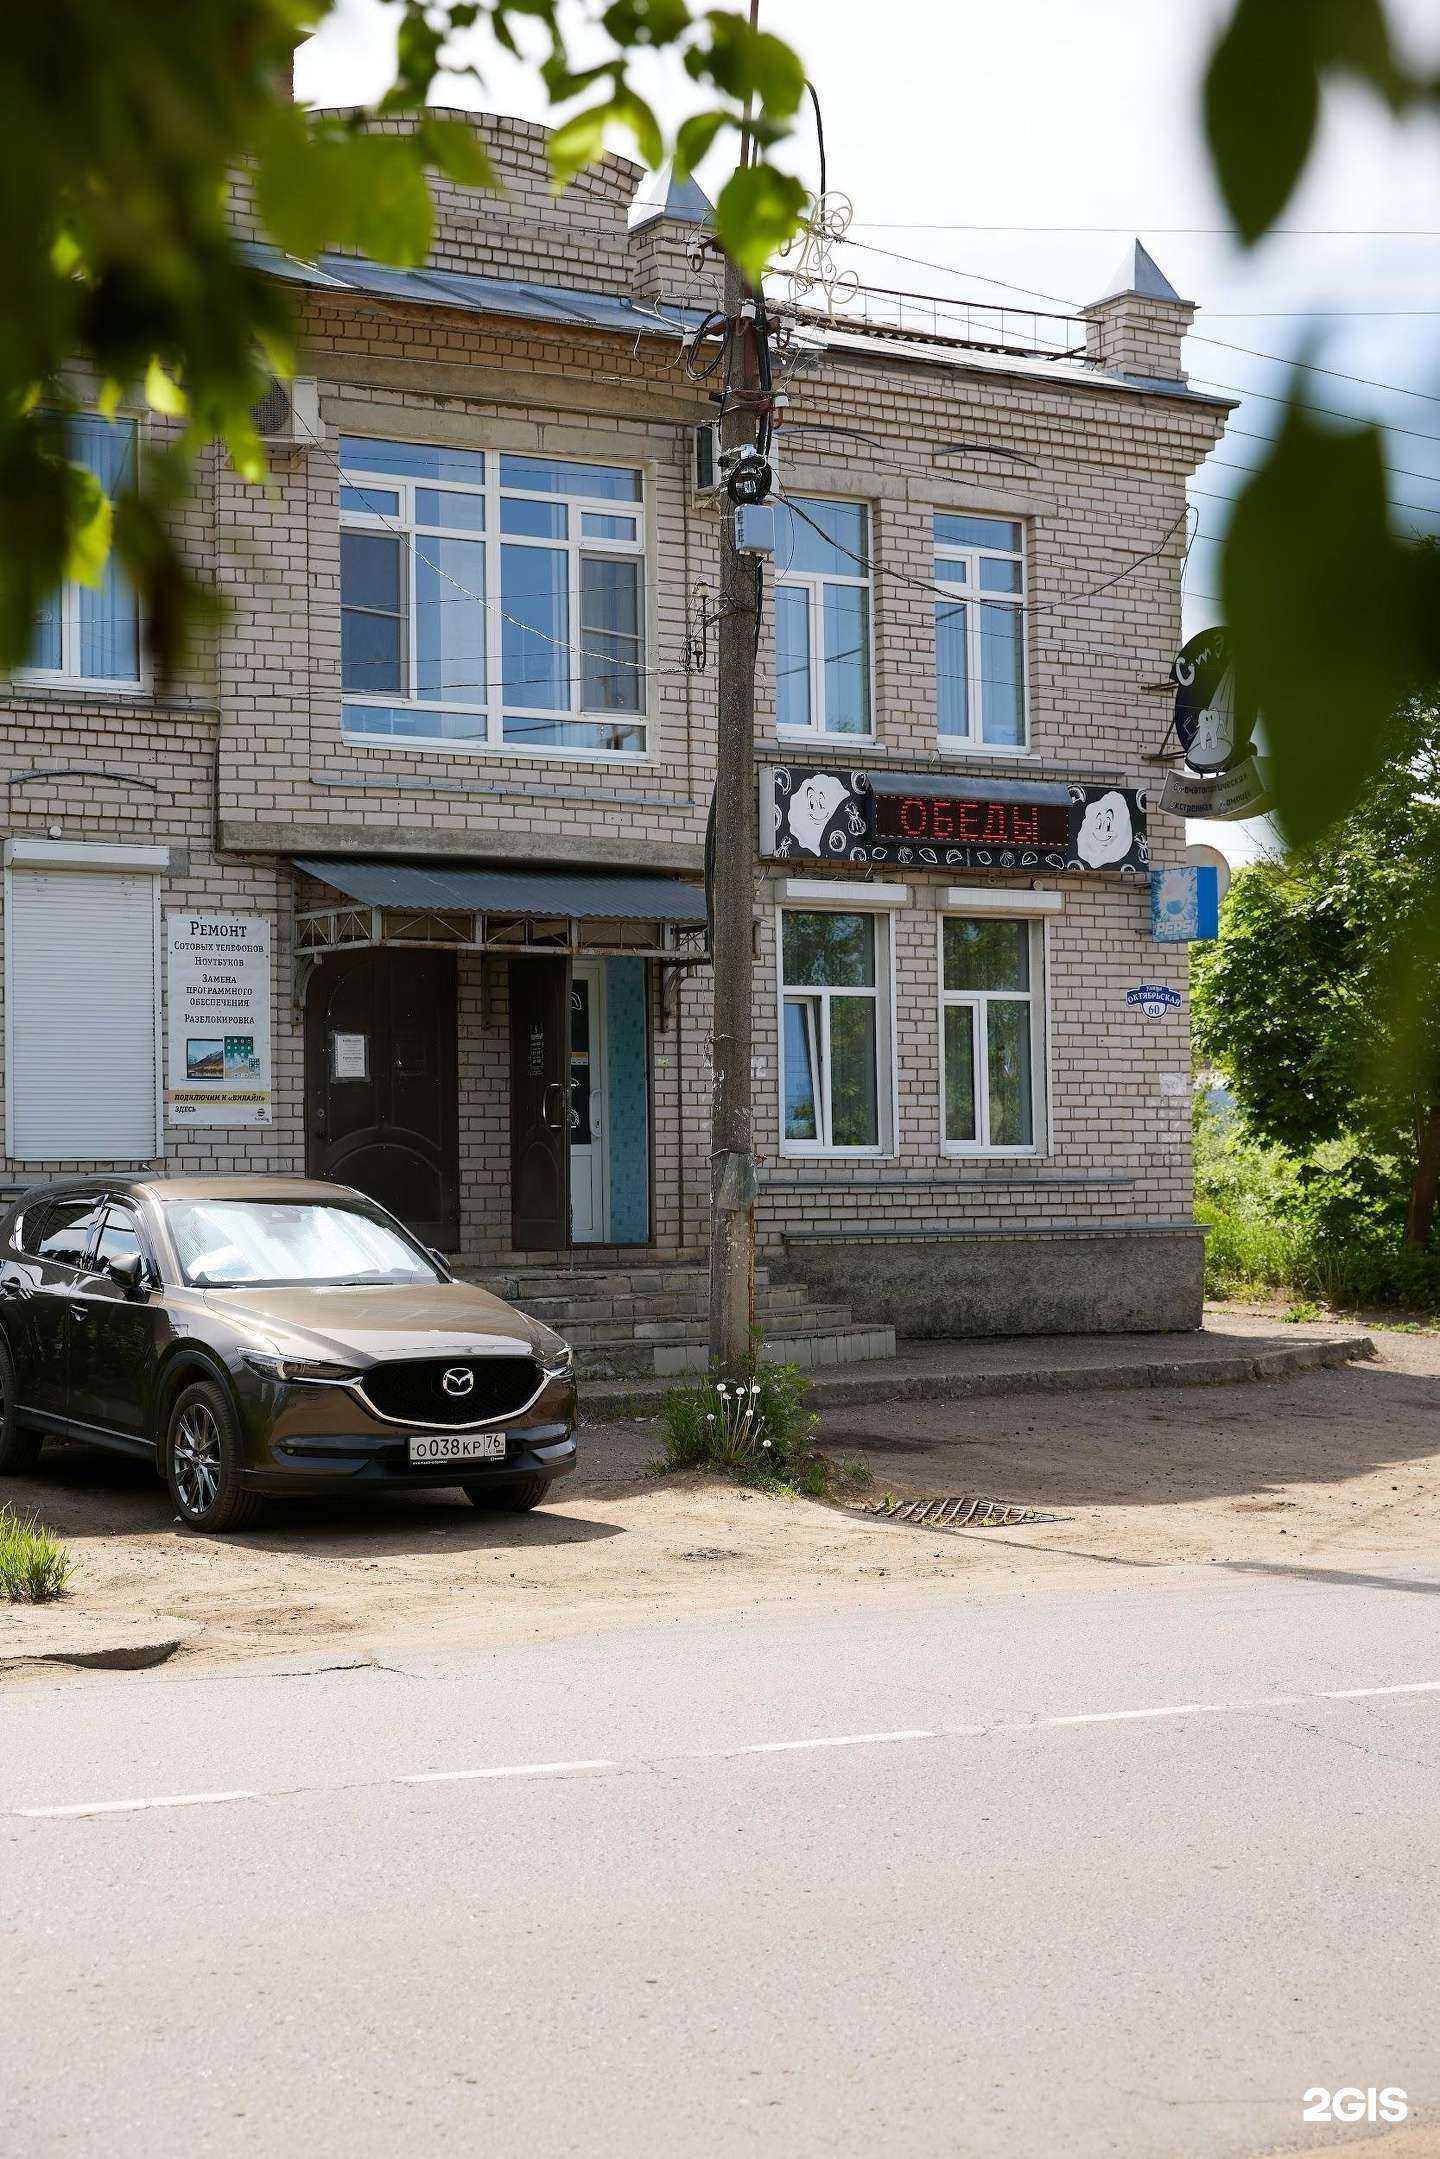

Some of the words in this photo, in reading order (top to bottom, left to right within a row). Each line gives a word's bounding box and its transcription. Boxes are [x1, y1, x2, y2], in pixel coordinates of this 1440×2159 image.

[900, 800, 1039, 841] ОБЕДЫ
[1127, 992, 1181, 1006] ОКТЯБРЬСКАЯ
[1148, 1004, 1160, 1015] 60
[174, 1105, 197, 1114] ЗДЕСЬ
[485, 1435, 501, 1449] 76
